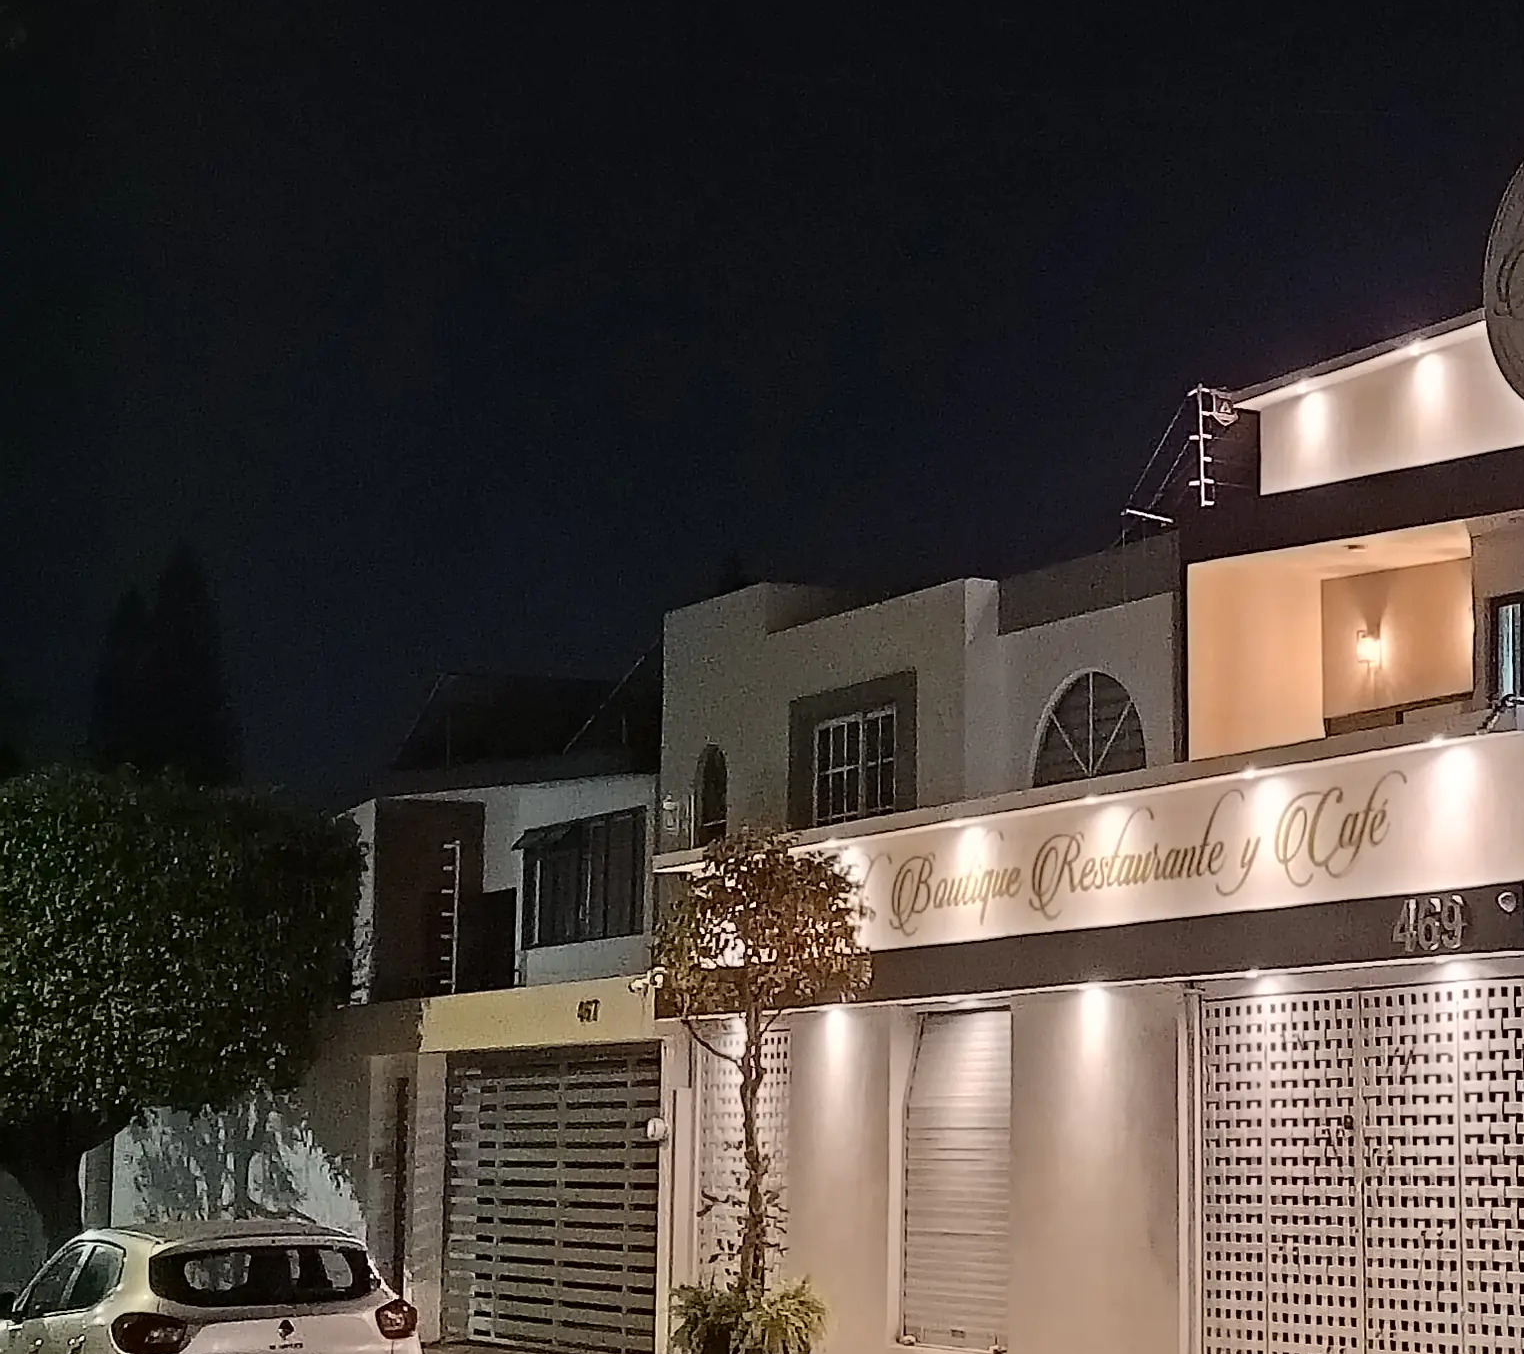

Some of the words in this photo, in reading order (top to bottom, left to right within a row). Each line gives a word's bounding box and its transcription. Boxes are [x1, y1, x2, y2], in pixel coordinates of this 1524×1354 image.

[889, 828, 1024, 938] Boutique
[1028, 788, 1247, 921] Restaurante
[1215, 835, 1262, 898] y
[1274, 769, 1408, 889] Café
[1391, 894, 1469, 953] 469
